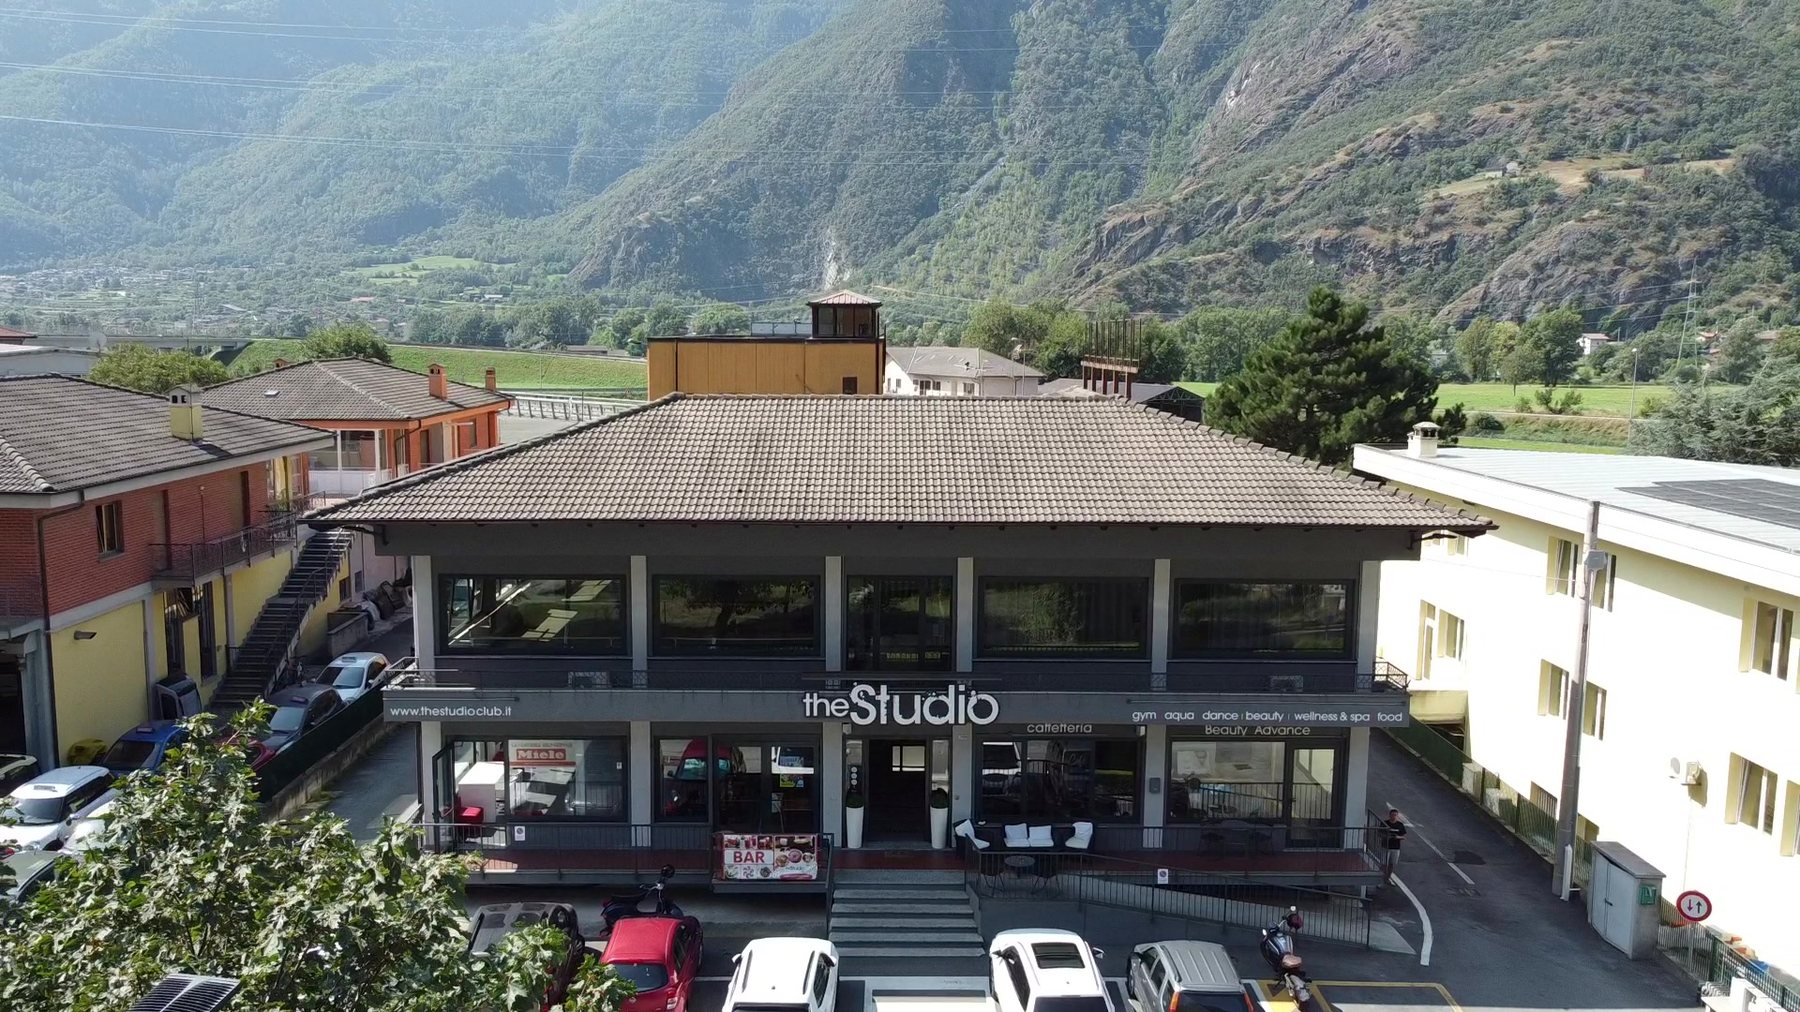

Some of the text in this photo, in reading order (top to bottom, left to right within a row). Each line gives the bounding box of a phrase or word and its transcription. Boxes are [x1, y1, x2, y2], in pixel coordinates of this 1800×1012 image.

[390, 706, 512, 717] www.thestudioclub.it
[1132, 710, 1403, 722] gym aqua dance beauty wellness & spa food
[1026, 722, 1093, 734] caffetteria
[1204, 724, 1311, 736] Beauty Advance
[517, 750, 565, 760] Miele
[733, 851, 765, 864] BAR
